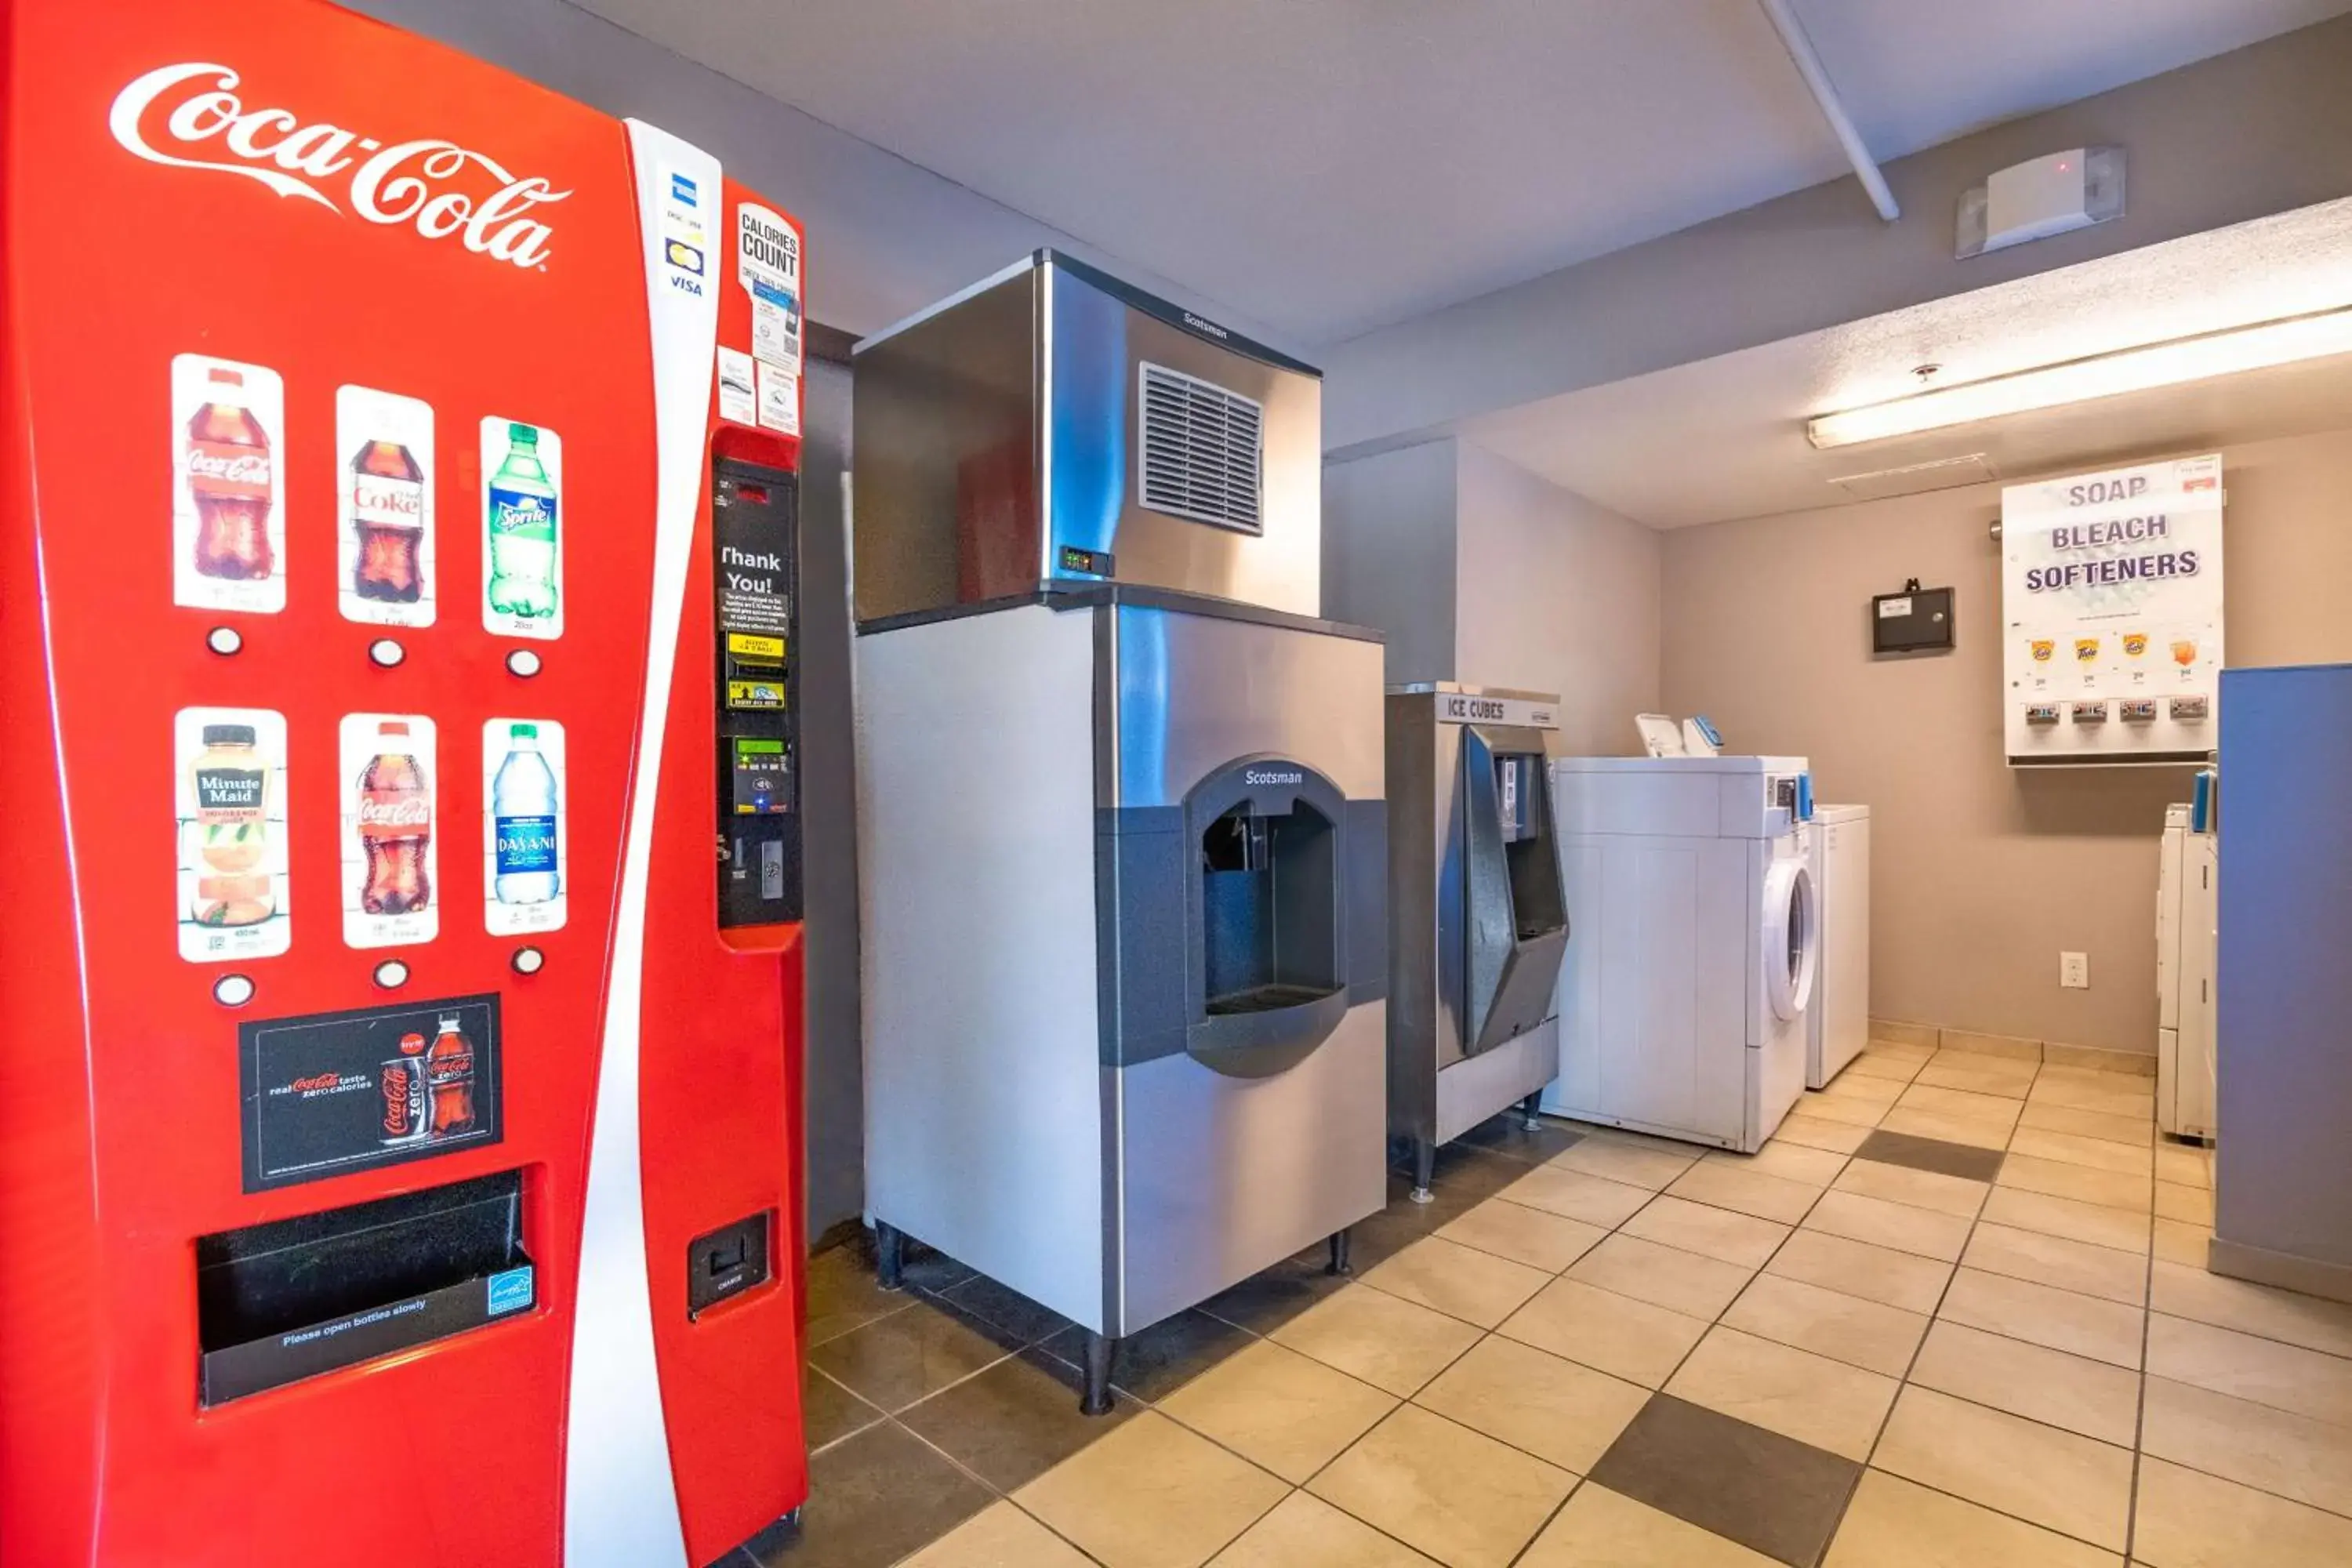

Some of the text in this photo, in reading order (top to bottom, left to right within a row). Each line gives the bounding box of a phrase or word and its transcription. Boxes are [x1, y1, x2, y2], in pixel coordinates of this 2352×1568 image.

[110, 63, 574, 272] Coca-Cola
[742, 213, 797, 255] CALORIES
[742, 232, 797, 277] COUNT
[670, 276, 702, 296] VISA
[1184, 313, 1228, 339] Scotsman
[354, 486, 419, 515] Coke
[2069, 477, 2148, 507] SOAP
[501, 508, 548, 532] Sprite
[2052, 514, 2167, 550] BLEACH
[720, 546, 782, 572] Thank
[2027, 550, 2198, 591] SOFTENERS
[727, 572, 772, 594] You!
[1448, 699, 1504, 720] ICE CUBES
[201, 776, 260, 791] Minute
[1245, 770, 1303, 786] Scotsman
[210, 789, 252, 803] Maid
[359, 797, 428, 825] Coca-Cola
[499, 836, 555, 854] DASANI
[431, 1058, 470, 1074] Coca-Cola
[437, 1069, 463, 1080] zero
[269, 1073, 367, 1096] real Coca-Cola taste
[302, 1080, 372, 1098] zero calories
[383, 1065, 408, 1134] Coca-Cola
[408, 1079, 423, 1117] zero
[283, 1299, 426, 1347] Please open bottles slowly
